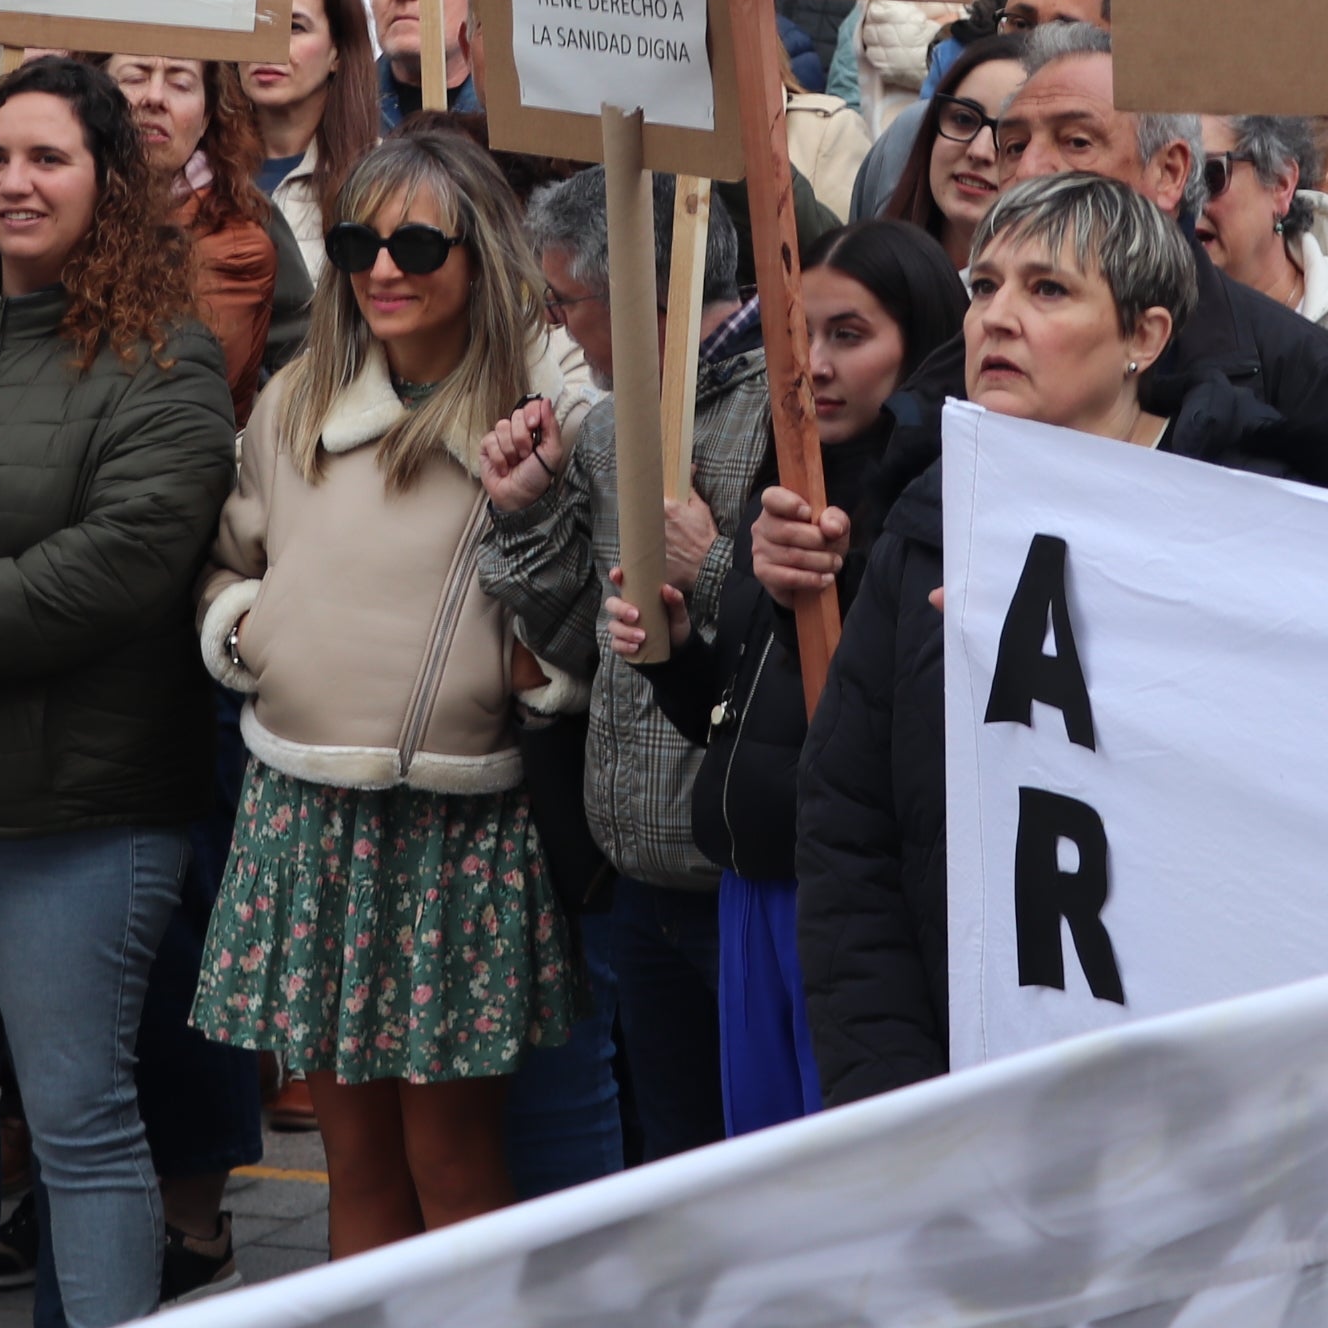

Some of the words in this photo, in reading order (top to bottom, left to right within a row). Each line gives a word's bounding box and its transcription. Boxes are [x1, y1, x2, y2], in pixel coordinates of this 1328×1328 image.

[532, 24, 552, 46] LA
[557, 26, 631, 55] SANIDAD
[637, 35, 690, 63] DIGNA
[672, 0, 684, 22] A
[985, 534, 1096, 752] A
[1016, 786, 1126, 1004] R
